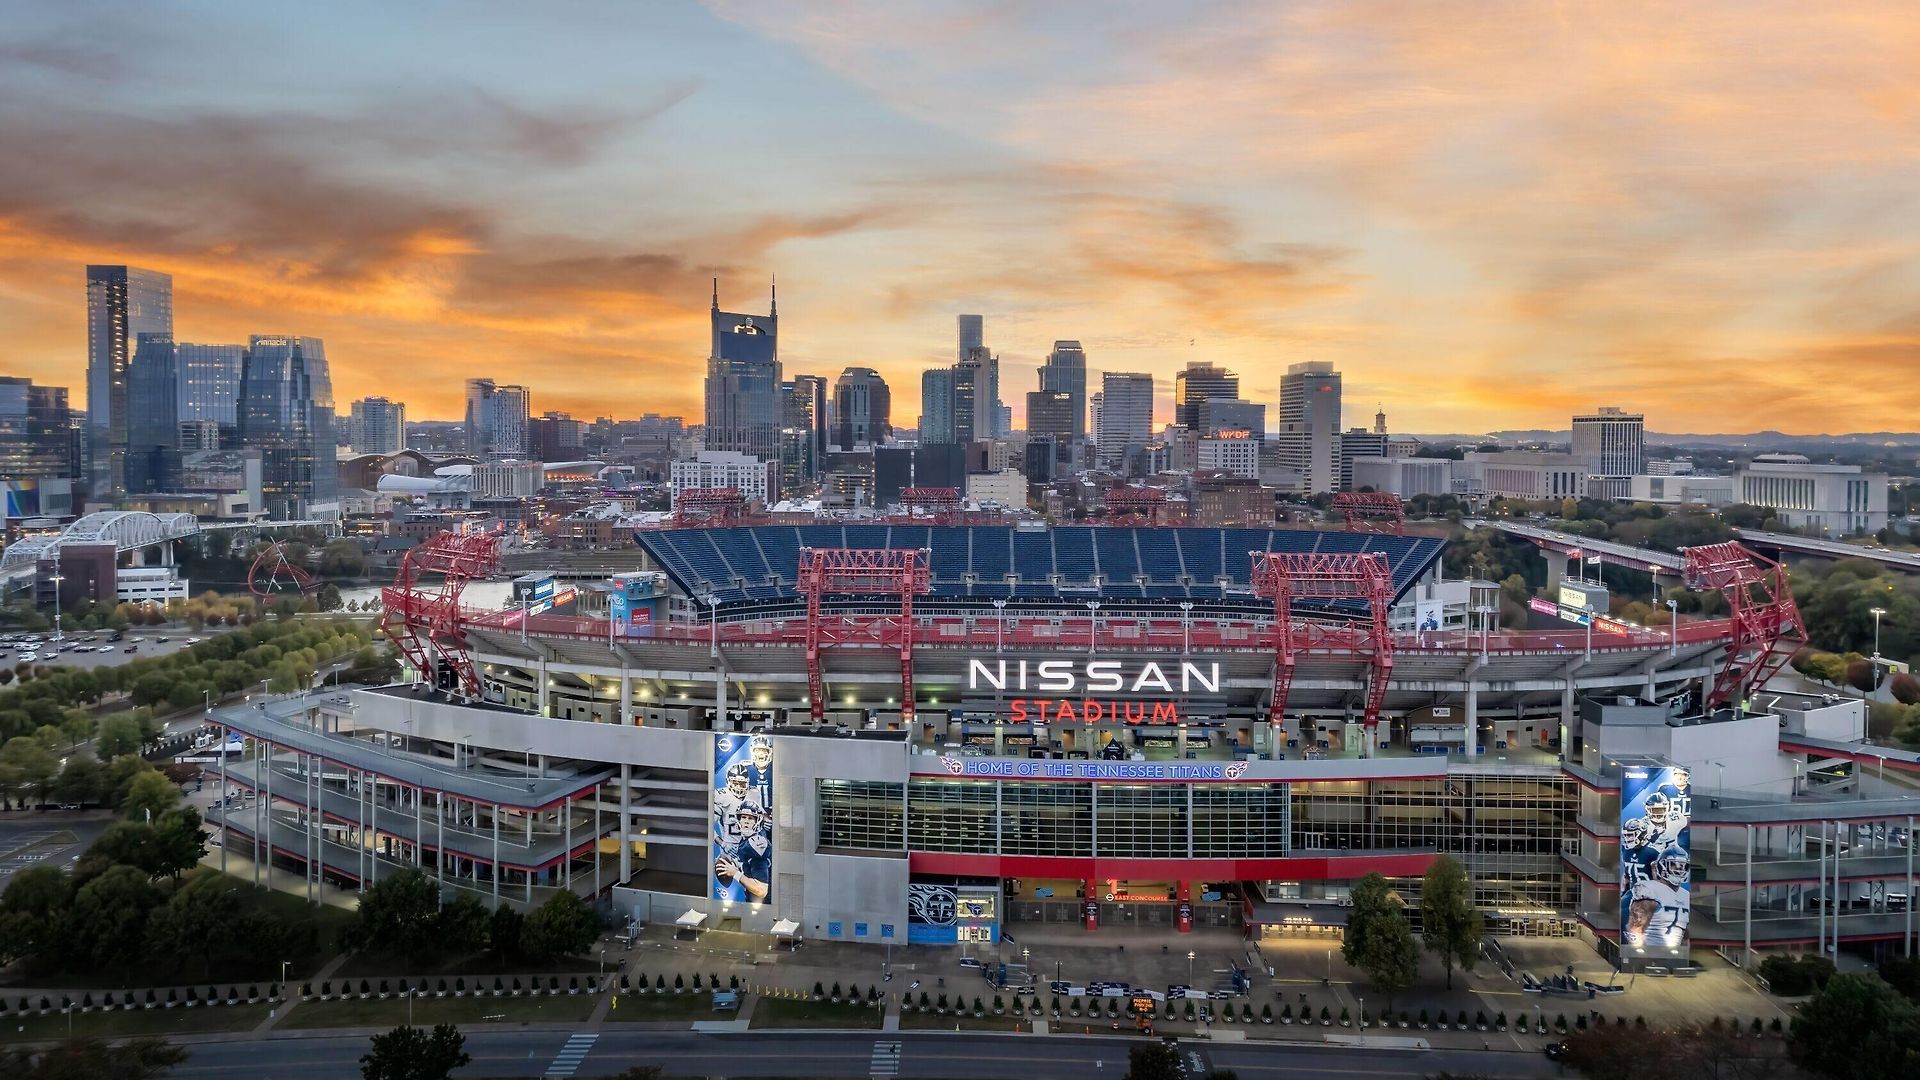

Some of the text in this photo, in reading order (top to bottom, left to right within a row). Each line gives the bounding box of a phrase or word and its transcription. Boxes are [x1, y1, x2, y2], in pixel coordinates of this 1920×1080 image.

[1598, 622, 1624, 634] NISSAN
[969, 659, 1220, 693] NISSAN
[1010, 700, 1178, 723] STADIUM
[967, 761, 1221, 778] HOME OF THE TENNESSEE TITANS
